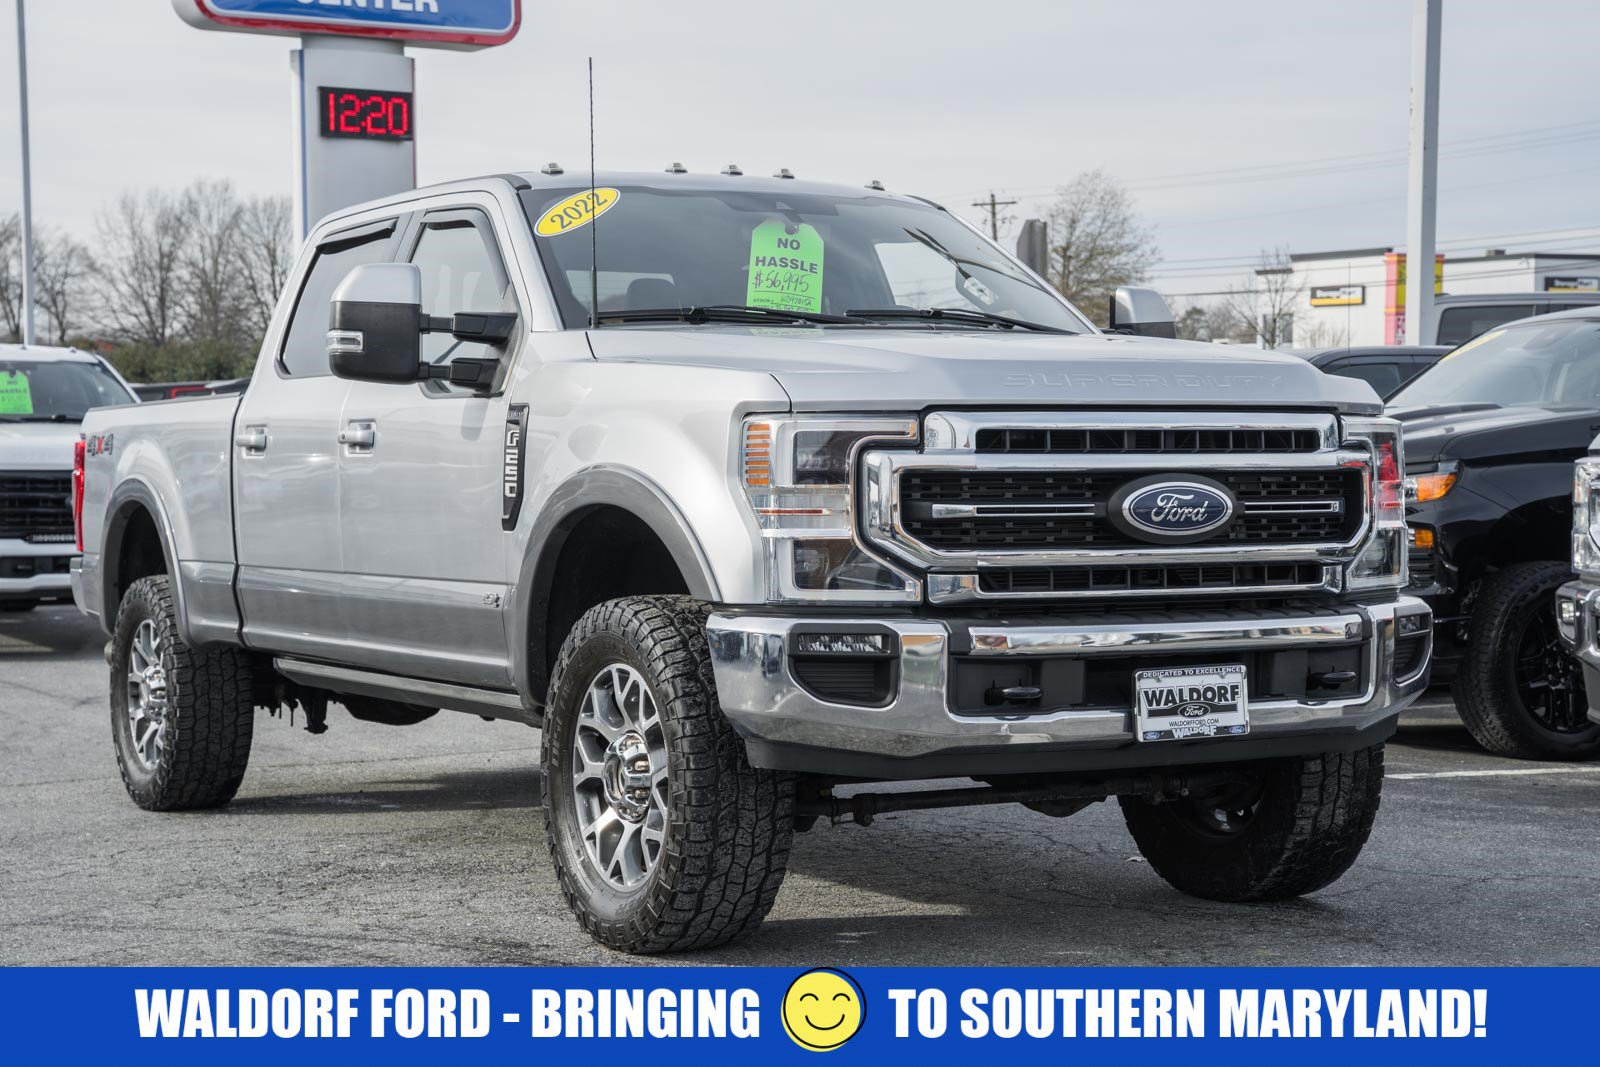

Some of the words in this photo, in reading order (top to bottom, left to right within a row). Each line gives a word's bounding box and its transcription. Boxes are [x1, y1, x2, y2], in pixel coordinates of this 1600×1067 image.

[328, 92, 409, 136] 12:20
[550, 192, 608, 230] 2022
[777, 237, 801, 251] NO
[755, 255, 818, 274] HASSLE
[1001, 373, 1168, 389] SUPER
[1176, 374, 1286, 389] DUTY
[1150, 493, 1209, 522] Ford
[1195, 666, 1241, 675] EXCELLENCE
[1143, 684, 1240, 708] WALDORF
[1184, 705, 1204, 717] Ford
[1169, 718, 1219, 728] WALDORFFORD.COM
